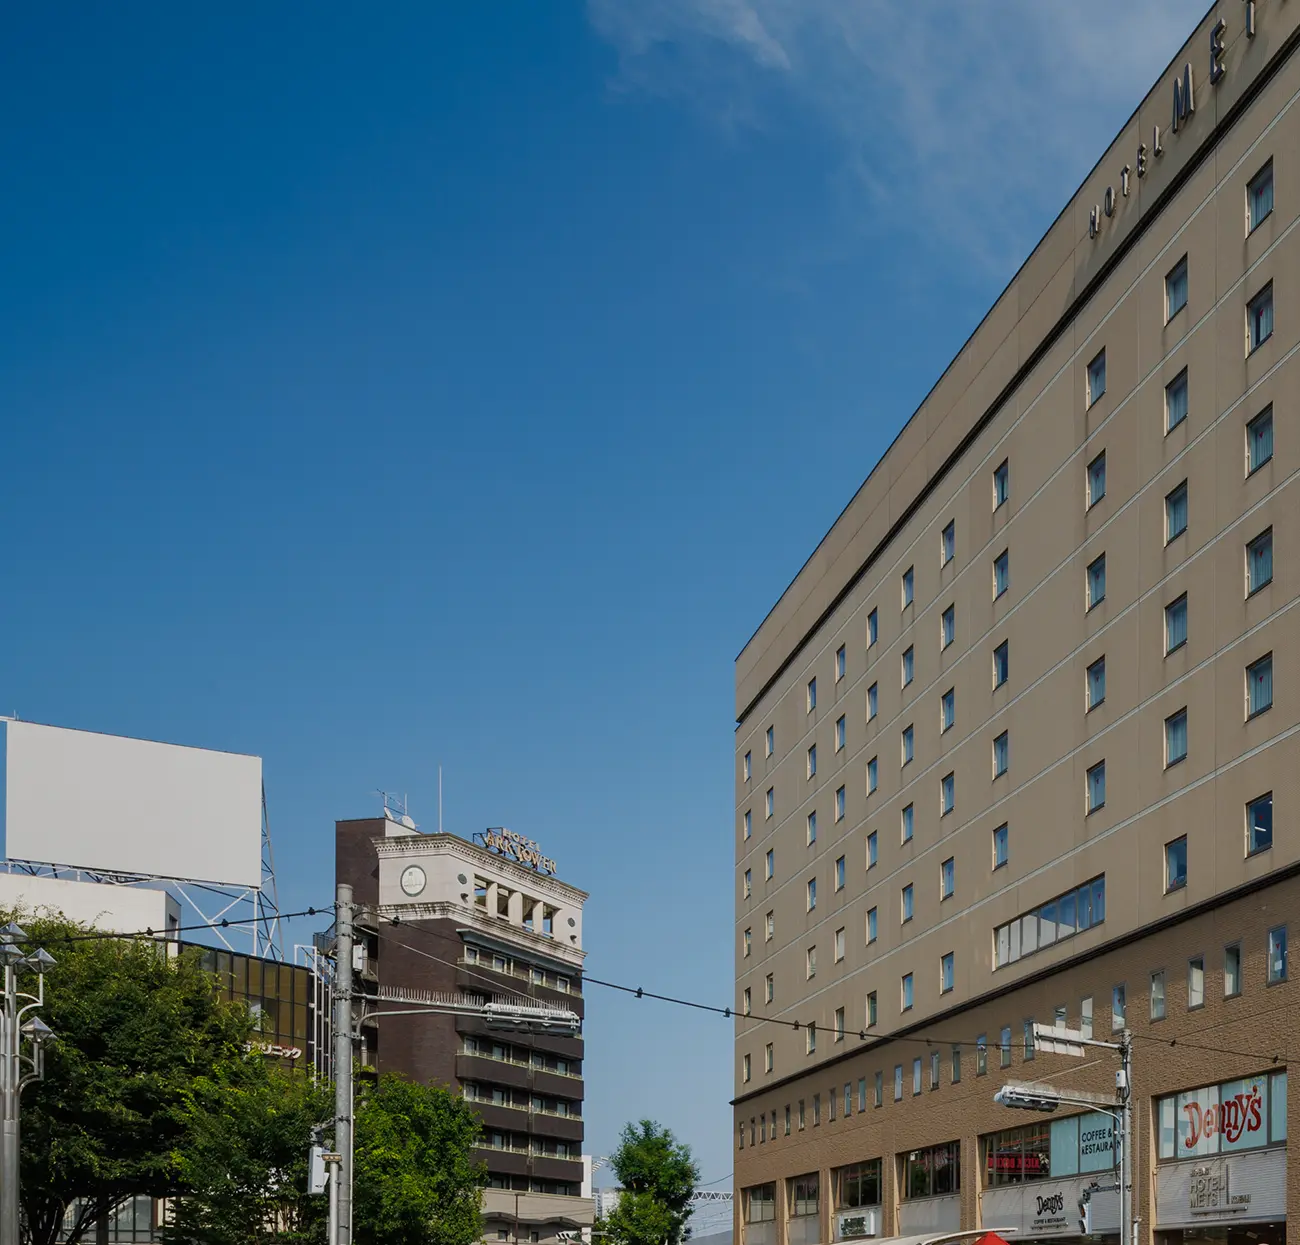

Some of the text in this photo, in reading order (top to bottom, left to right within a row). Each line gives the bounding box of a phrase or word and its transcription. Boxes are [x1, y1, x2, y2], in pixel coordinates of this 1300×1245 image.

[1089, 125, 1162, 239] HOTEL
[503, 828, 540, 852] HOTEL
[515, 844, 557, 875] TOWER
[1184, 1085, 1261, 1149] Denny's
[1081, 1127, 1112, 1142] COFFEE &
[1190, 1175, 1226, 1194] HOTEL
[1036, 1192, 1064, 1216] Denny's
[1190, 1191, 1219, 1208] METS
